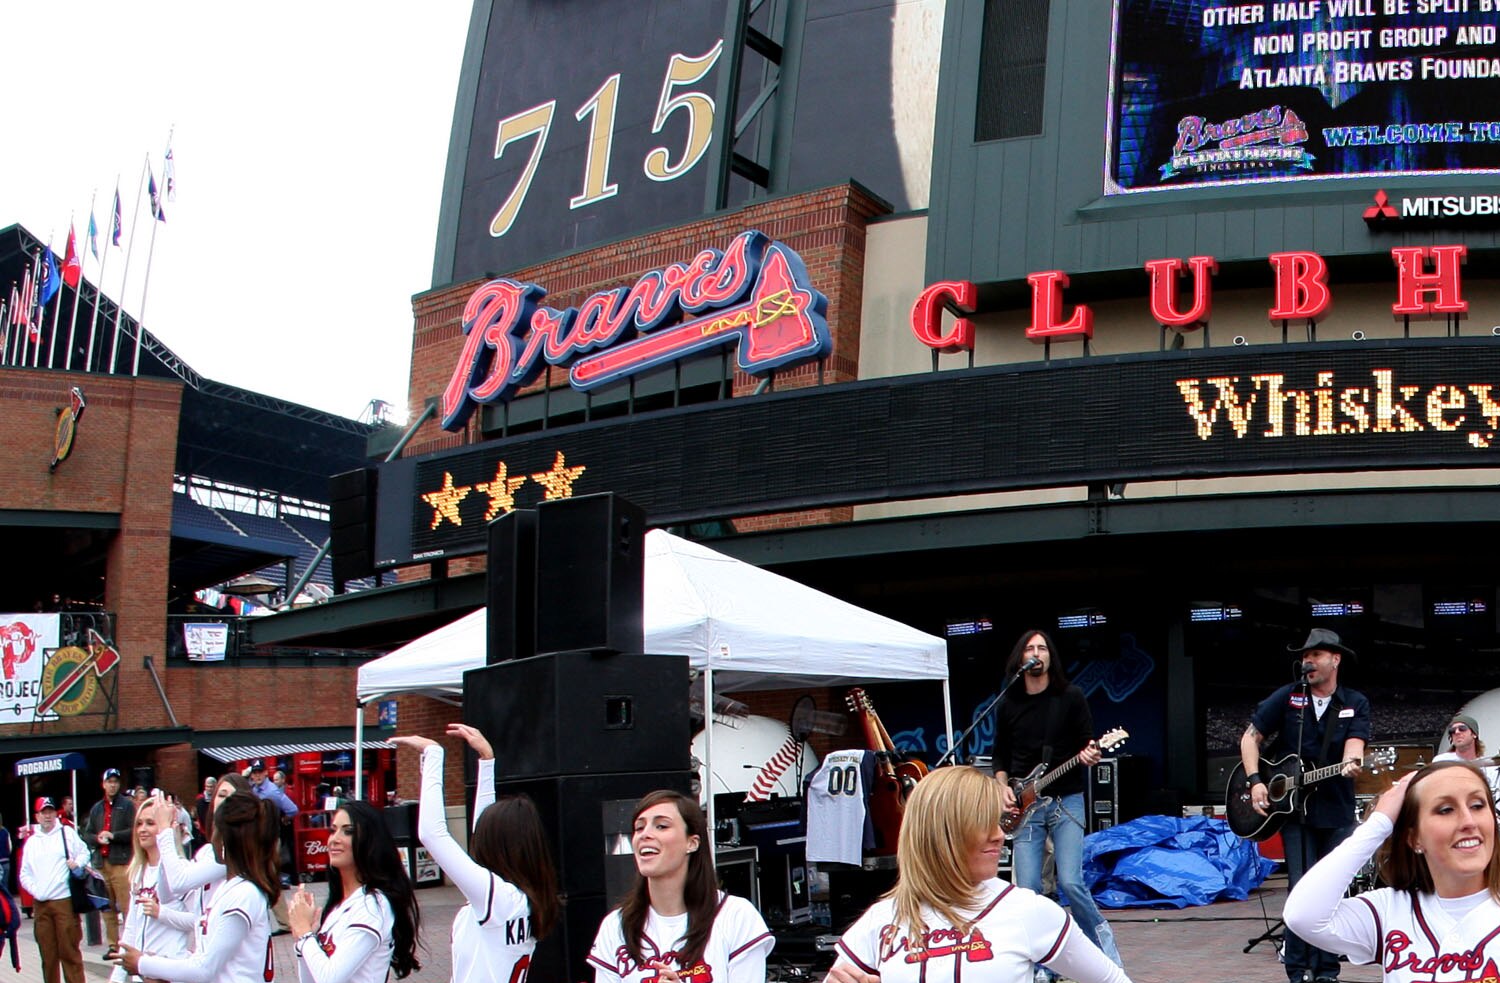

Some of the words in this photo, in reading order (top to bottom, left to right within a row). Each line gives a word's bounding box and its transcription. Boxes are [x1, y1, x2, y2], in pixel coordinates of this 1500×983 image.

[1203, 4, 1264, 28] OTHER
[1273, 1, 1320, 21] HALF
[1327, 0, 1376, 18] WILL
[1383, 0, 1410, 15] BE
[1416, 0, 1468, 14] SPLIT
[1253, 34, 1294, 55] NON
[1302, 30, 1372, 52] PROFIT
[1379, 27, 1447, 48] GROUP
[1456, 25, 1496, 45] AND
[1239, 65, 1326, 90] ATLANTA
[1334, 61, 1413, 84] BRAVES
[489, 38, 725, 238] 715
[1173, 105, 1282, 157] Braves
[1322, 122, 1463, 148] WELCOME
[443, 230, 766, 432] Braves
[17, 759, 62, 776] PROGRAMS
[827, 766, 857, 796] 00
[1384, 930, 1484, 974] Braves
